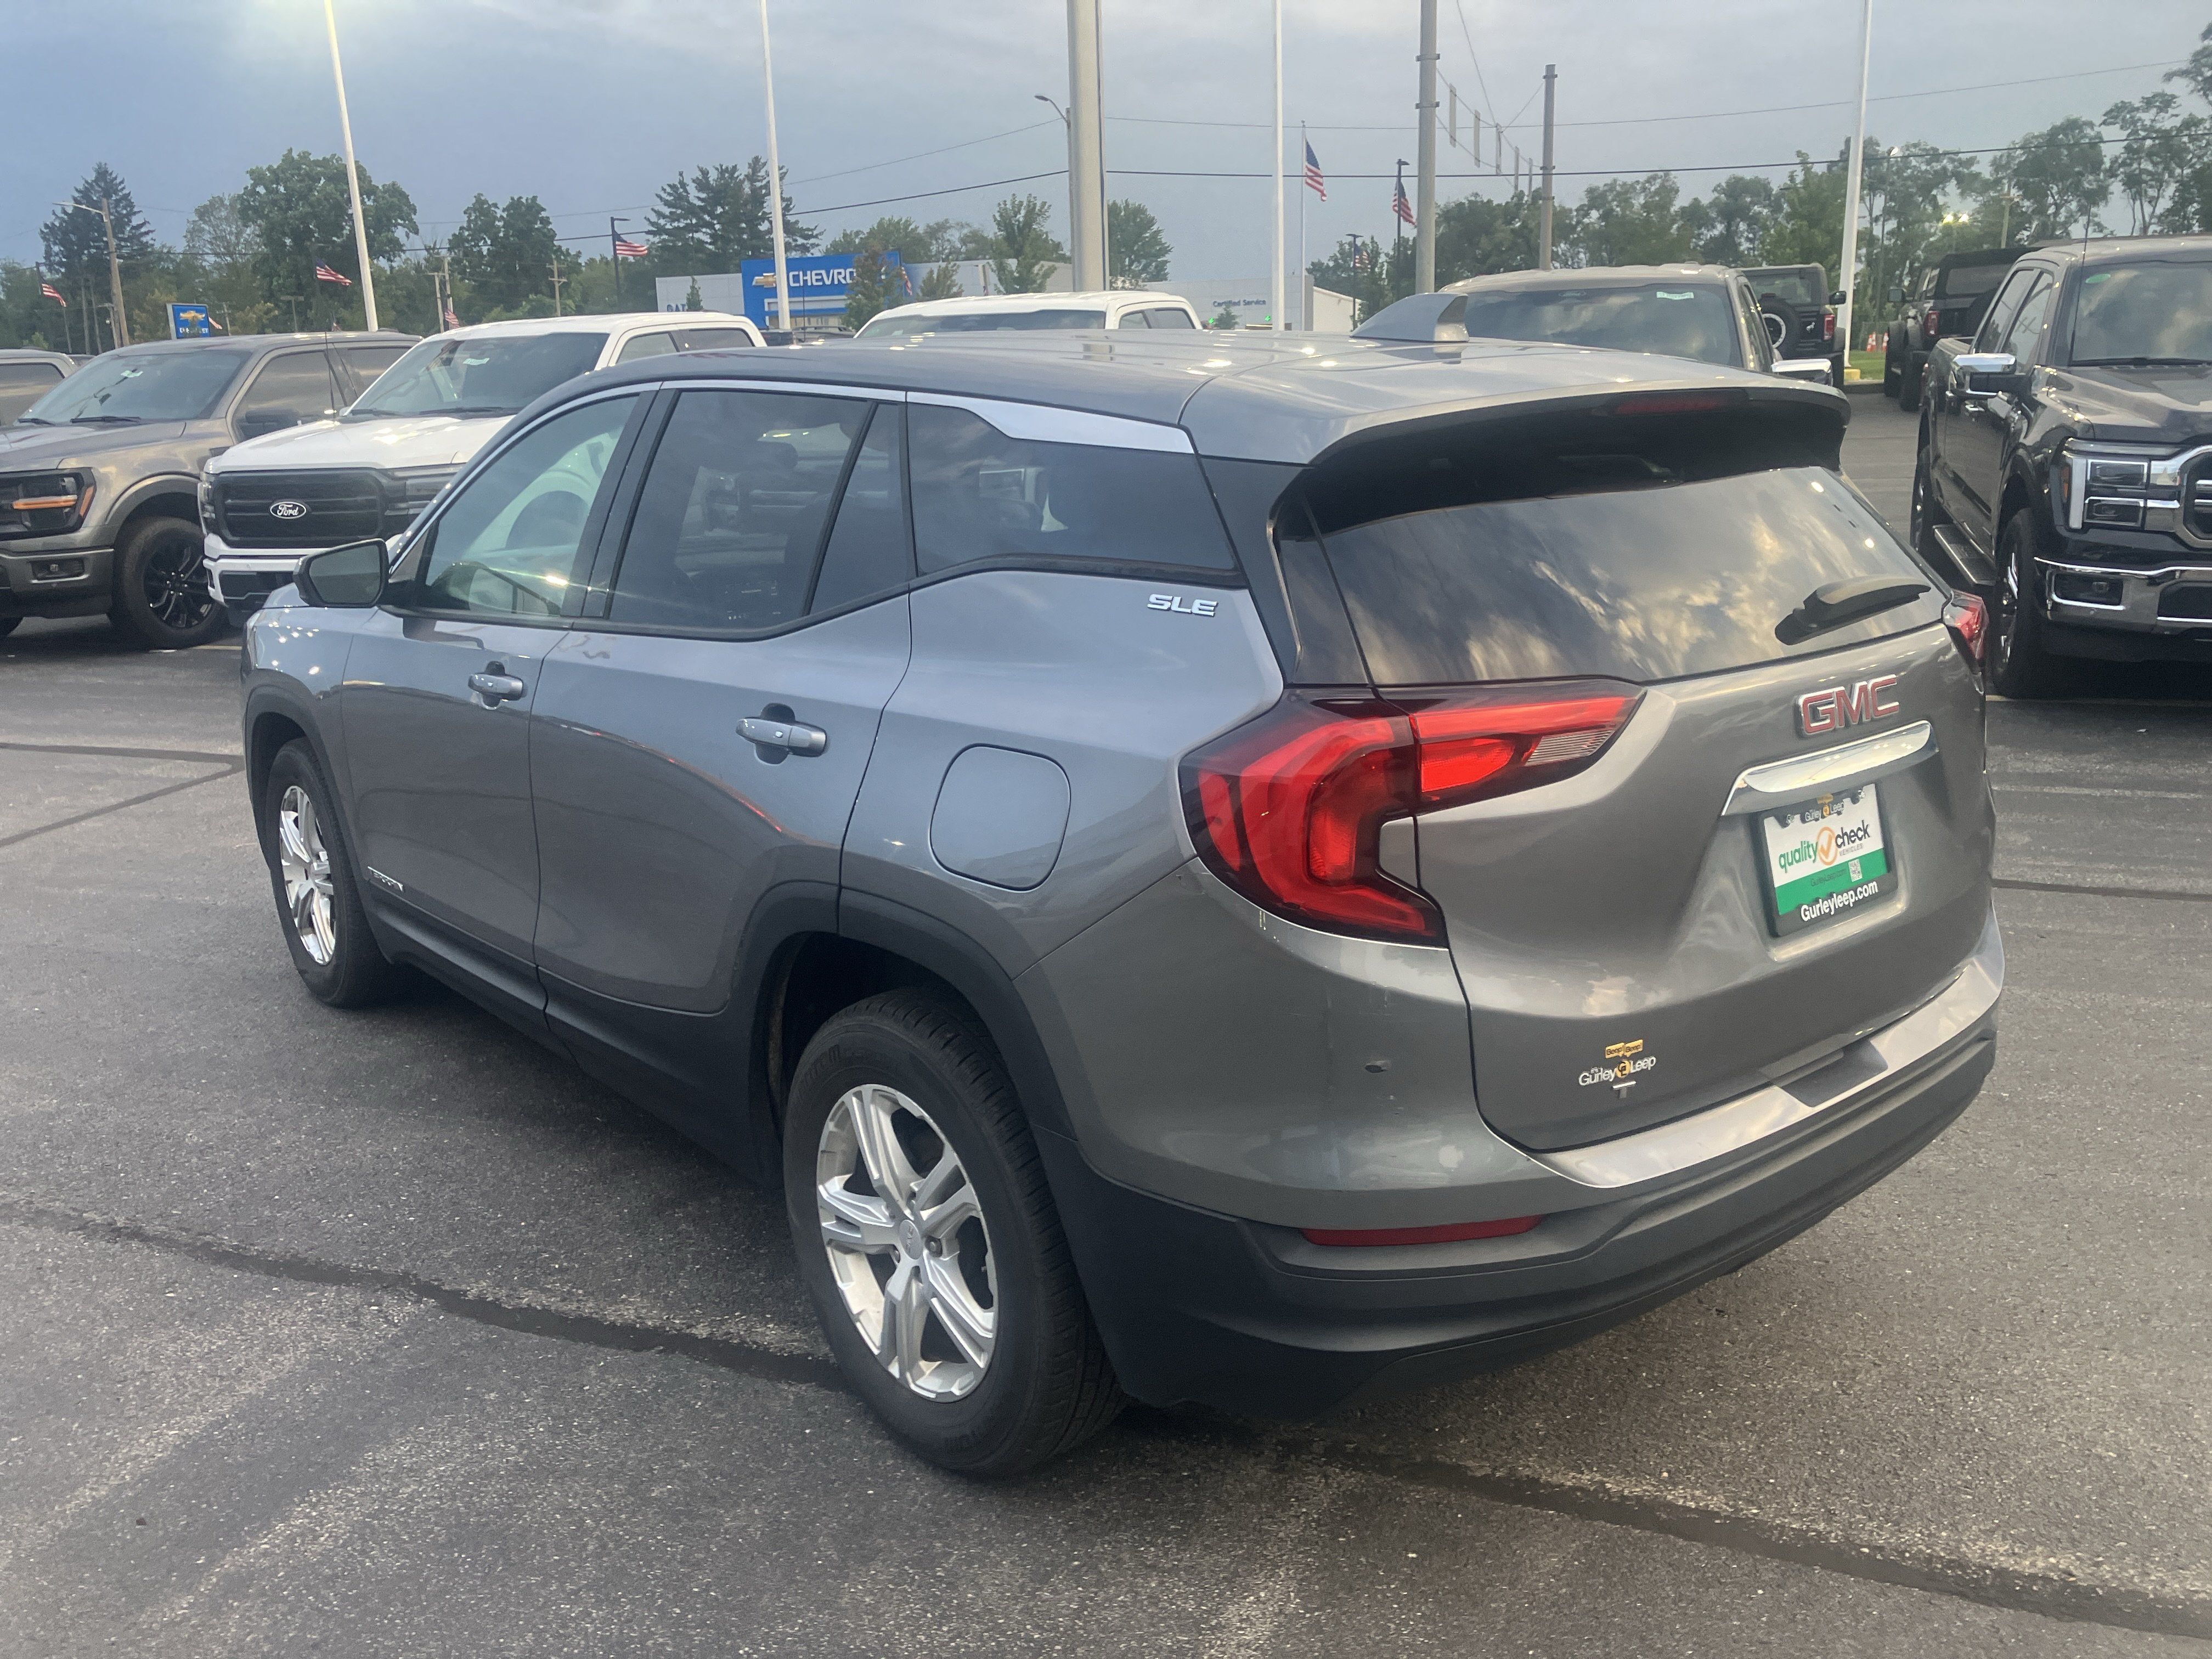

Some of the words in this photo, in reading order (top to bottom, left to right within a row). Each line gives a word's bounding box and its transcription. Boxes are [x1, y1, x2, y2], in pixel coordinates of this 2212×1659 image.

[789, 268, 856, 287] CHEVRO
[277, 504, 298, 516] Ford
[1147, 594, 1218, 617] SLE
[1798, 674, 1899, 735] GMC
[1779, 840, 1819, 873] quality
[1835, 820, 1871, 849] check
[1838, 843, 1863, 856] VEHICLES
[1800, 881, 1878, 922] Gurleyleep.com
[1579, 1067, 1617, 1086] Gurley
[1630, 1056, 1656, 1074] Leep
